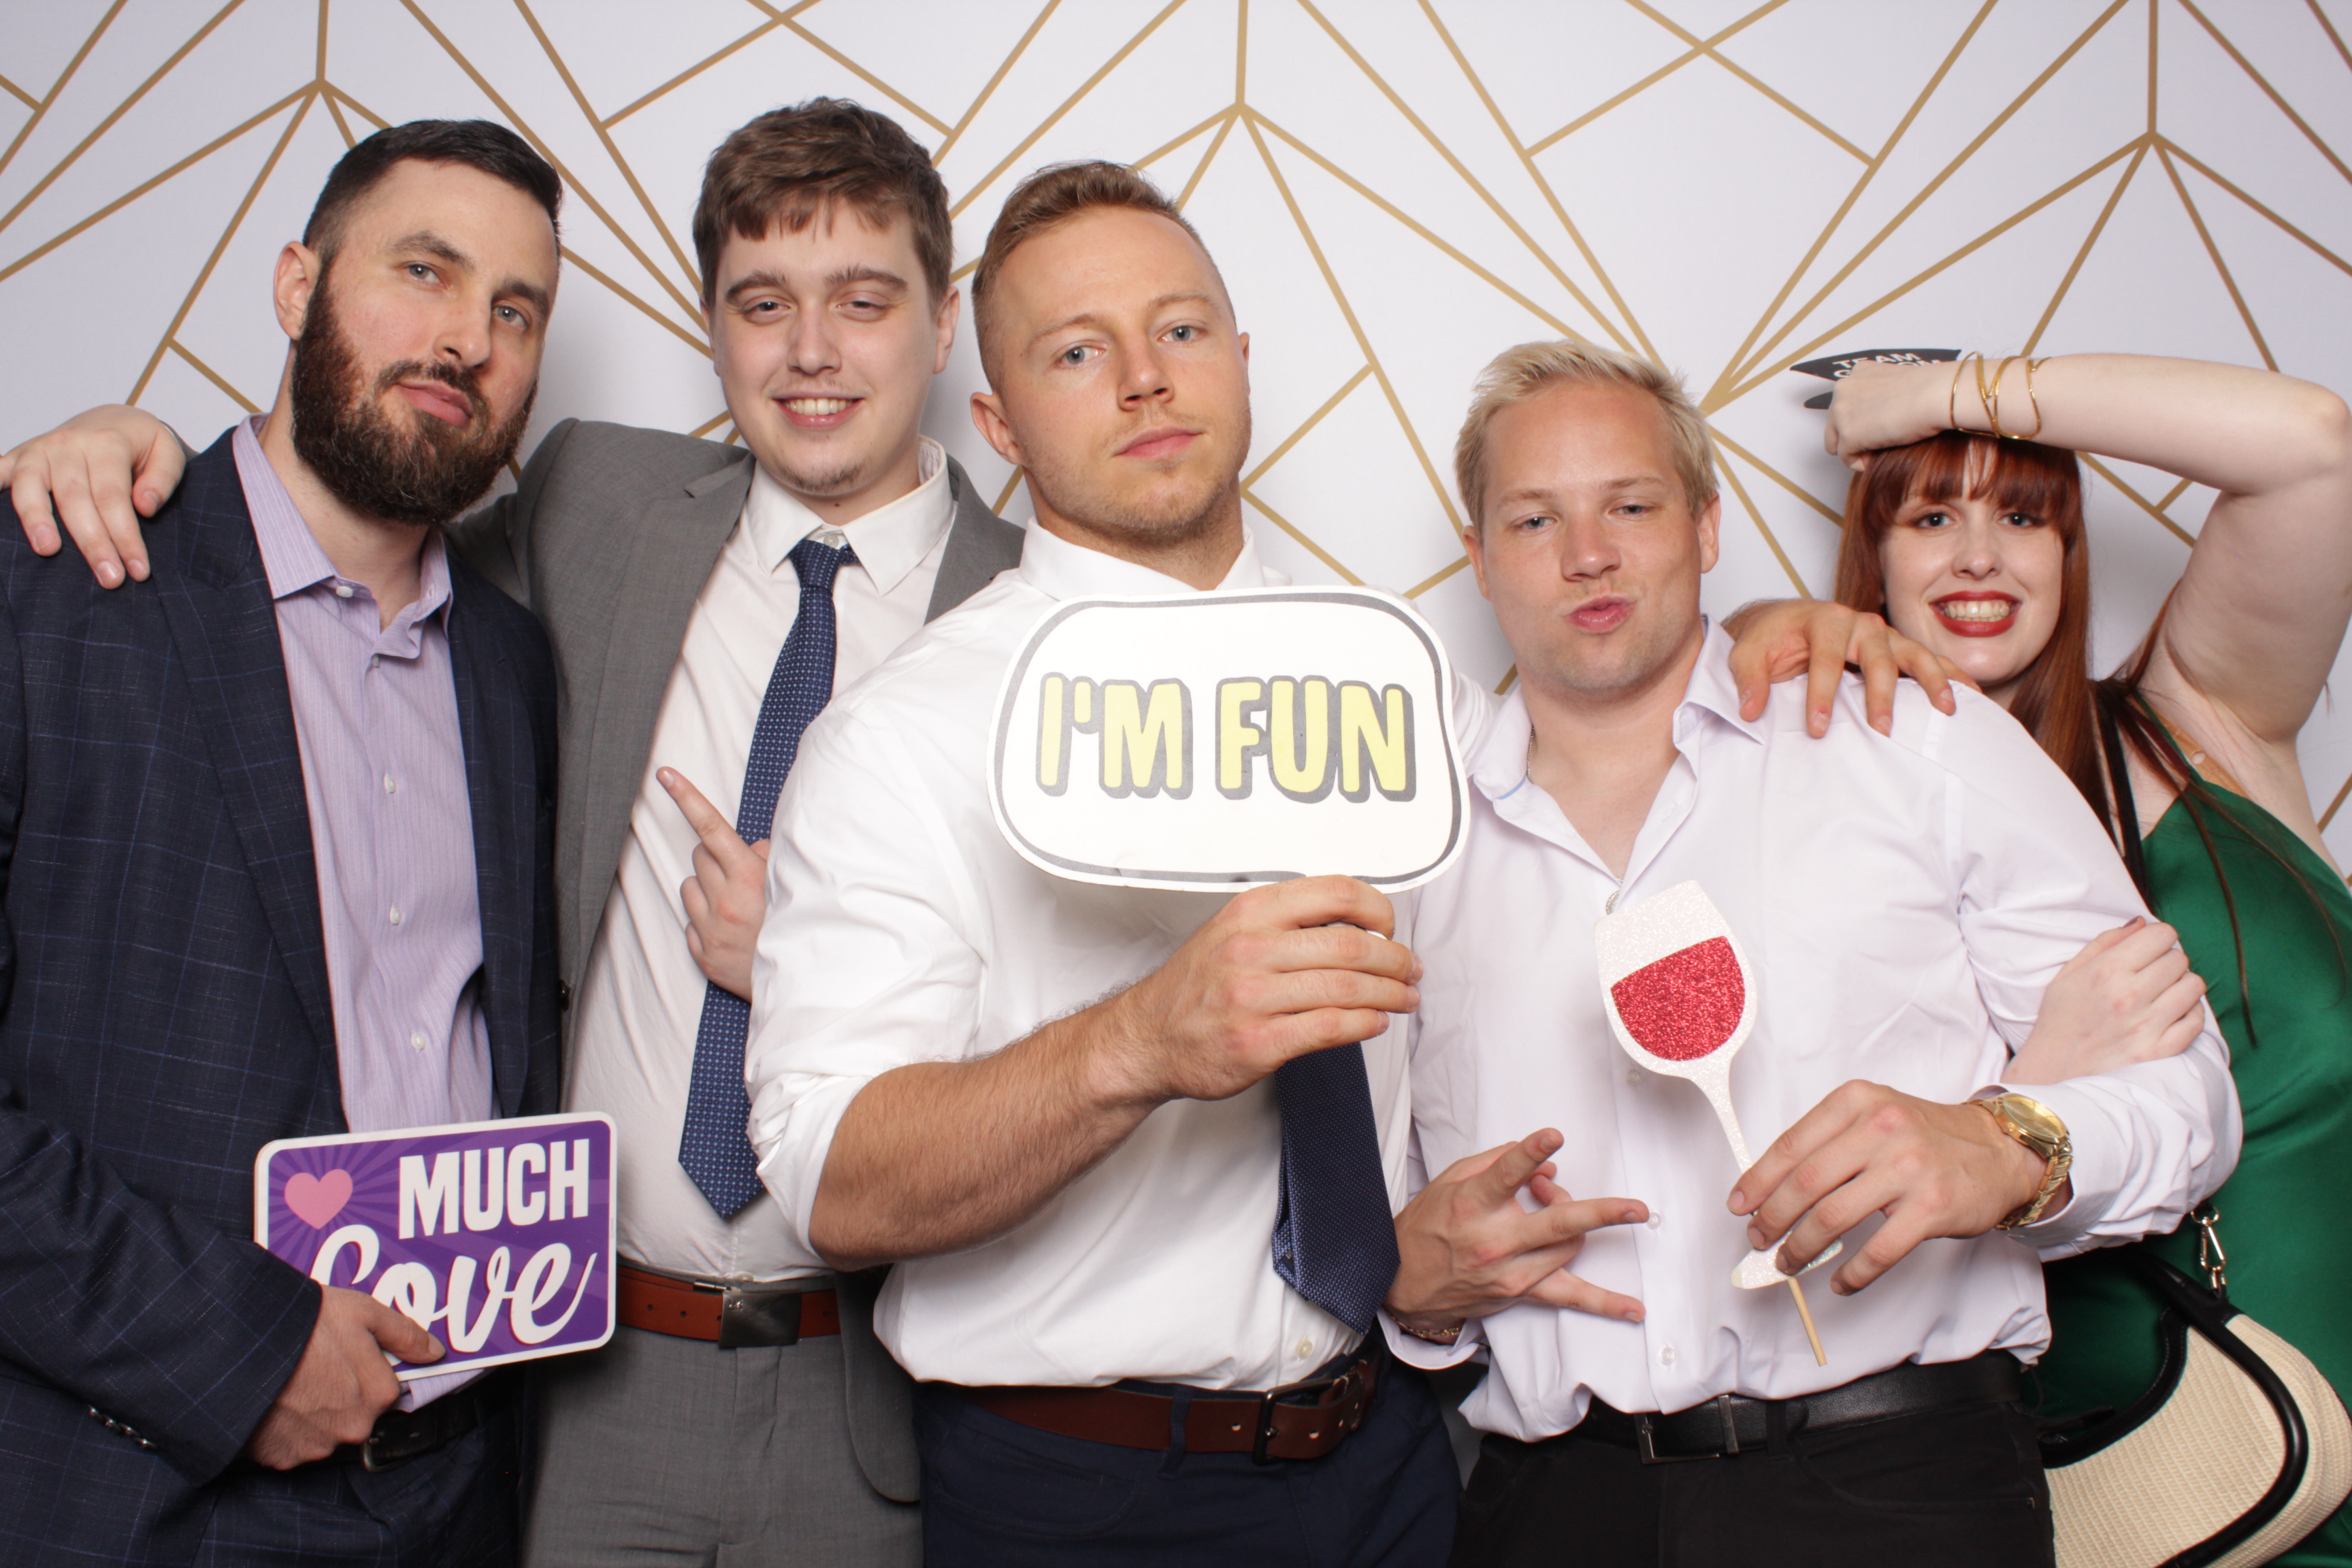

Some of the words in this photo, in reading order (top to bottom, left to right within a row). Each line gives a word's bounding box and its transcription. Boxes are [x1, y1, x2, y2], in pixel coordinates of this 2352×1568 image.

[1036, 672, 1194, 800] I'M
[1215, 674, 1417, 804] FUN
[399, 1138, 590, 1240] MUCH
